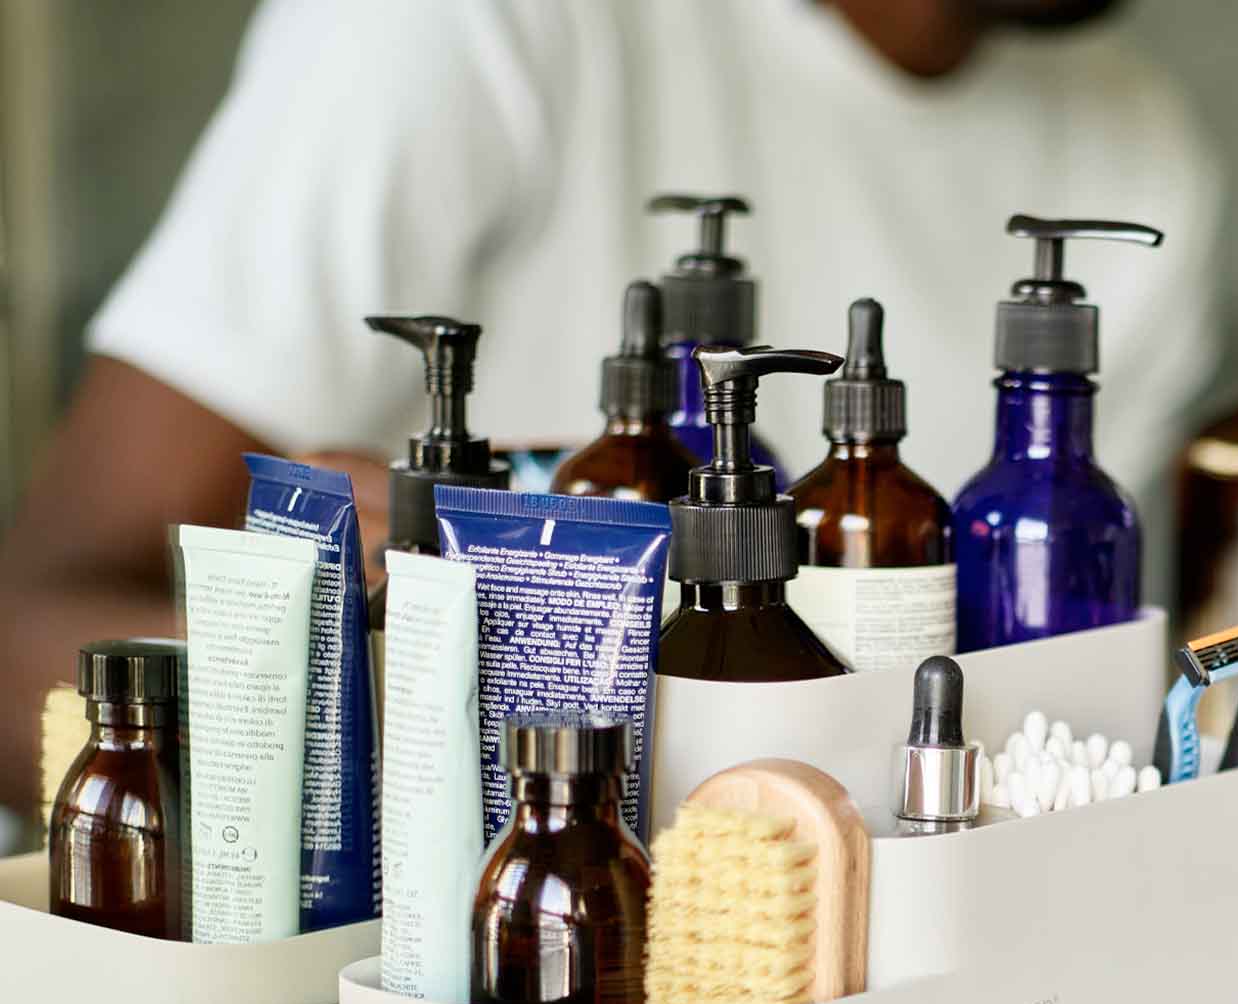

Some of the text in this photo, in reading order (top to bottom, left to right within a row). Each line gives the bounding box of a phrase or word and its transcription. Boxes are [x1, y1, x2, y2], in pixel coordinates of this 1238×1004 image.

[491, 584, 504, 592] face
[548, 597, 572, 606] MODO
[483, 617, 514, 627] Appliquer
[509, 636, 560, 648] ANWENDUNG:
